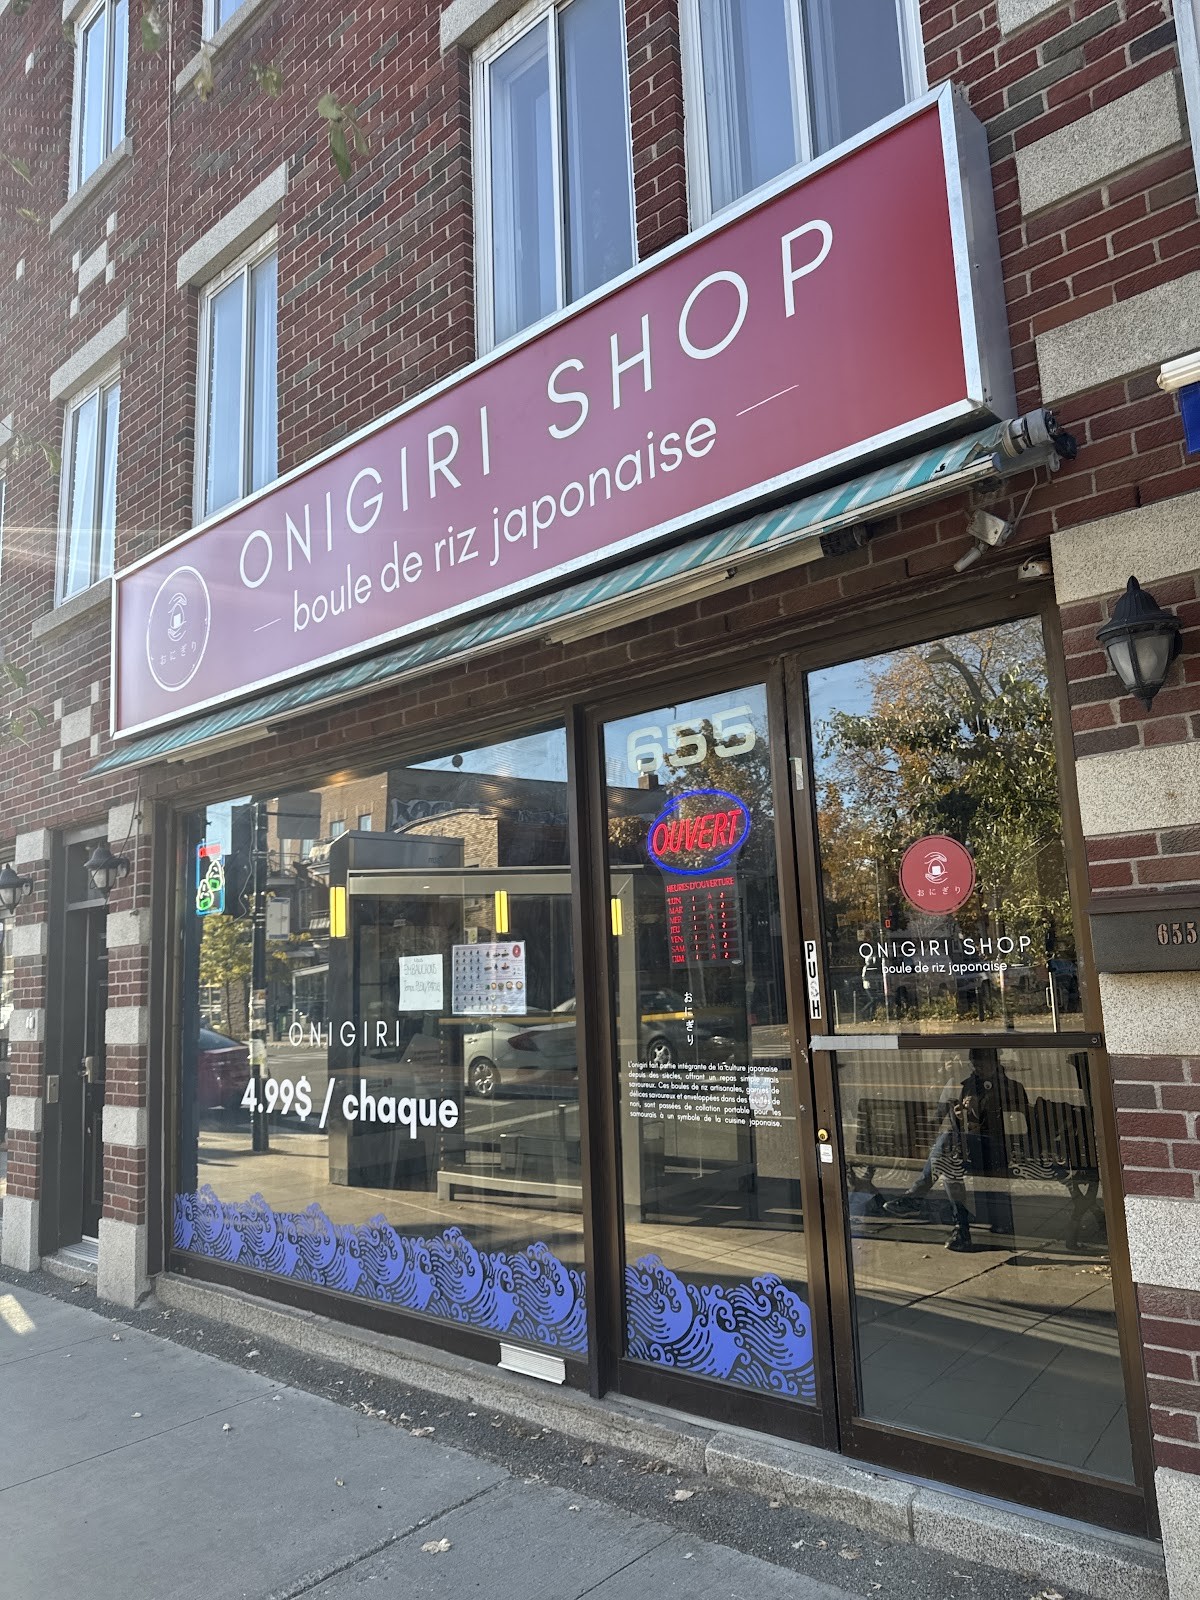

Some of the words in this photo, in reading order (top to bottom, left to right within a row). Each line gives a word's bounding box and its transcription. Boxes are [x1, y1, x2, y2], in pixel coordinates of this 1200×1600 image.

[239, 405, 490, 589] ONIGIRI
[547, 219, 834, 440] SHOP
[293, 563, 372, 633] boule
[380, 540, 423, 593] de
[434, 526, 479, 572] riz
[489, 417, 717, 566] japonaise
[160, 641, 197, 665] おにぎり
[626, 706, 756, 774] 655
[652, 809, 742, 856] OUVERT
[666, 882, 690, 893] HEURES
[917, 886, 961, 897] おにぎり
[669, 906, 683, 914] MAR
[1157, 922, 1198, 945] 655
[672, 945, 686, 953] SAM
[859, 939, 949, 959] ONIGIRI
[963, 935, 1032, 955] SHOP
[882, 961, 912, 974] boule
[914, 961, 929, 972] de
[932, 962, 946, 973] riz
[948, 960, 1007, 975] japonaise
[684, 991, 694, 1046] おにぎり
[288, 1020, 400, 1047] ONIGIRI
[660, 1062, 676, 1070] partie
[678, 1062, 706, 1071] intégrante
[748, 1065, 778, 1073] japonaise
[628, 1070, 646, 1079] depuis
[662, 1072, 682, 1080] siècles,
[685, 1072, 705, 1080] offrant
[740, 1074, 760, 1083] simple
[671, 1082, 689, 1090] boules
[710, 1084, 744, 1093] artisanales,
[771, 1086, 780, 1094] de
[629, 1090, 648, 1098] délices
[684, 1093, 720, 1102] enveloppées
[737, 1095, 747, 1103] des
[240, 1075, 312, 1122] 4.99$
[342, 1078, 459, 1140] chaque
[659, 1102, 681, 1110] passées
[696, 1104, 720, 1112] collation
[724, 1106, 750, 1114] portable
[772, 1108, 781, 1116] les
[677, 1113, 700, 1121] symbole
[704, 1114, 712, 1122] de
[749, 1119, 782, 1127] japonaise.
